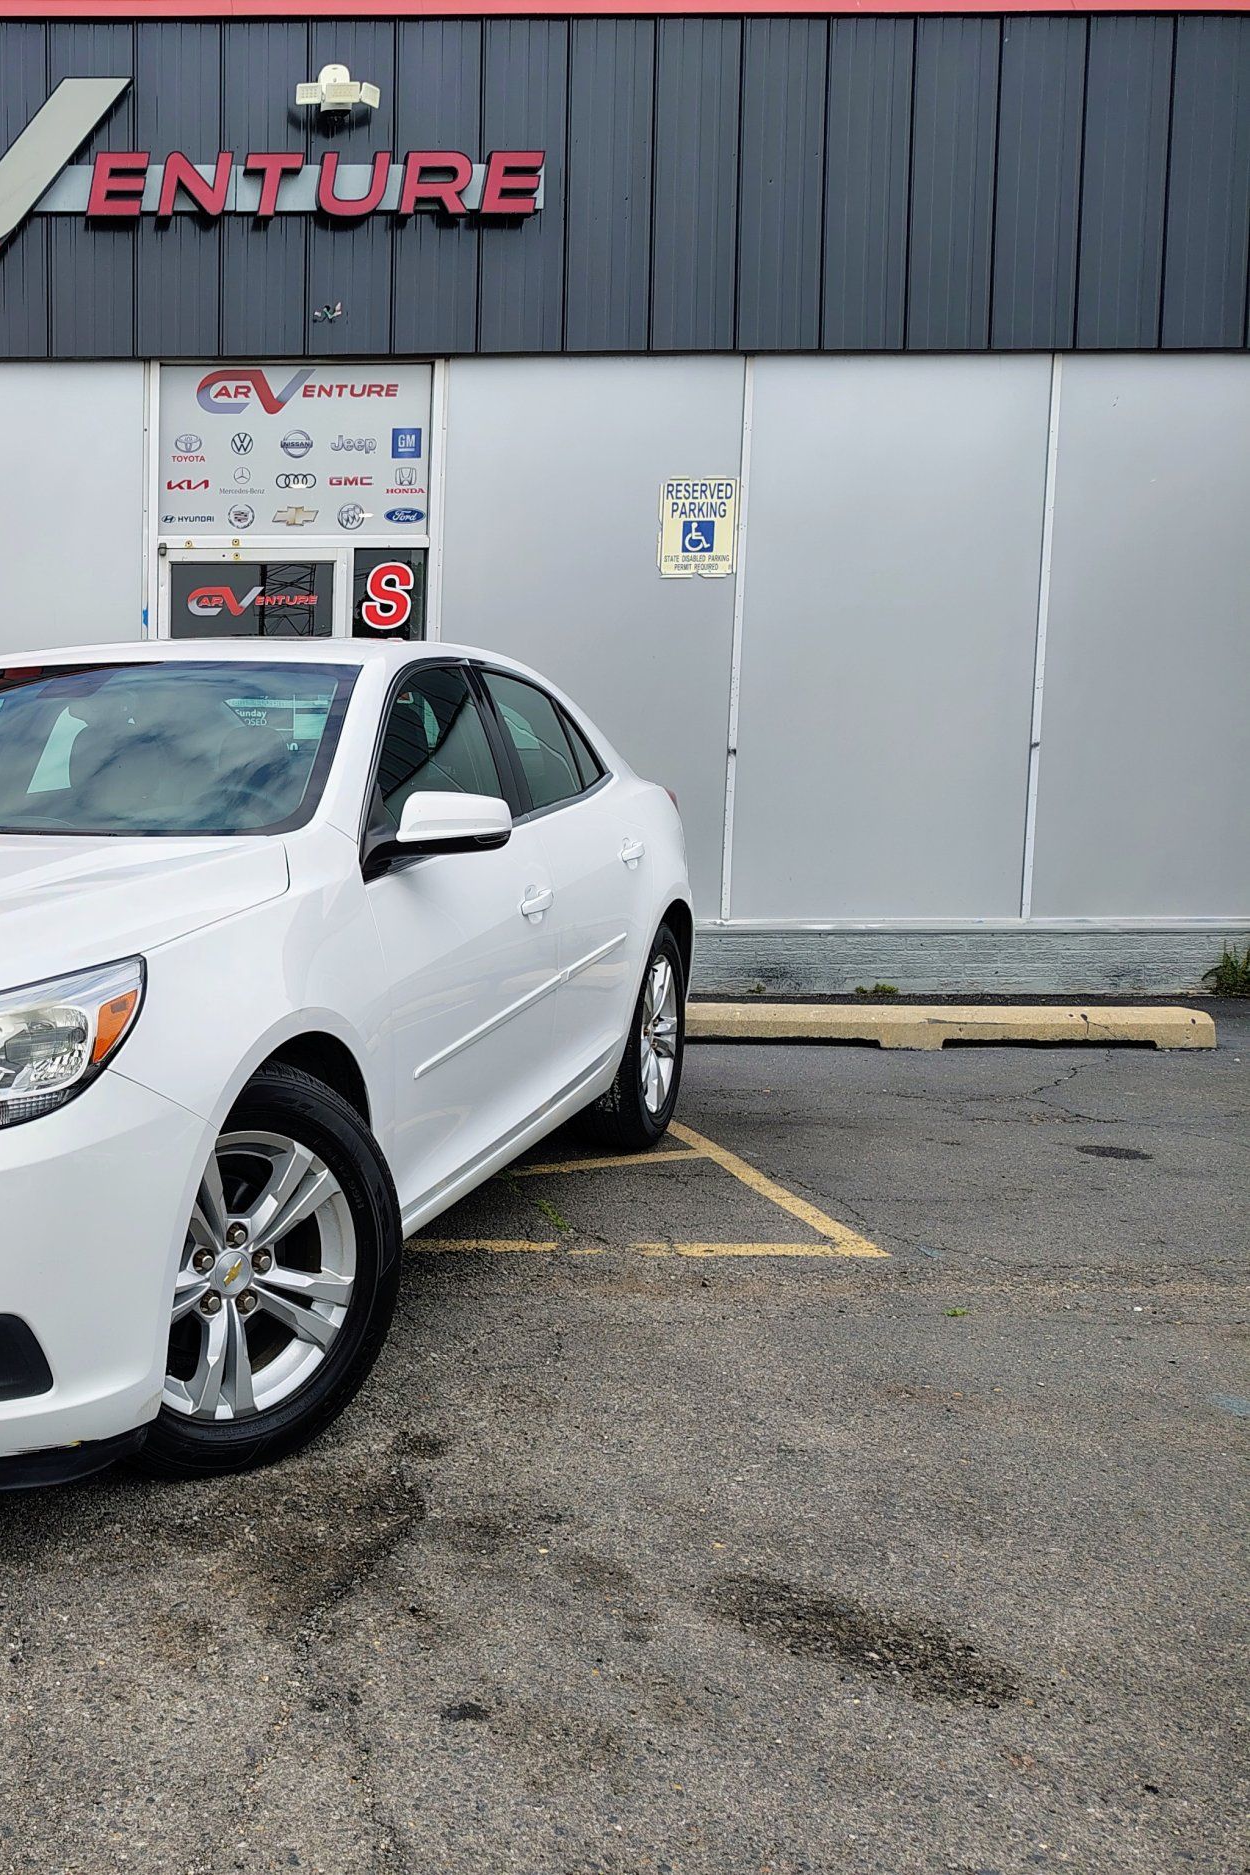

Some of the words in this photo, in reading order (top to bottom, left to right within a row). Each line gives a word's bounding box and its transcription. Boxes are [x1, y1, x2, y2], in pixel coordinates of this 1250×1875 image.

[282, 440, 311, 448] NISSAN
[330, 434, 377, 454] Jeep
[397, 434, 416, 448] GM
[171, 455, 206, 463] TOYOTA
[166, 479, 210, 490] KIA
[329, 476, 373, 486] GMC
[218, 487, 266, 495] Mercedes-Benz
[666, 483, 734, 500] RESERVED
[671, 501, 727, 518] PARKING
[177, 515, 215, 523] HYUNDAI
[392, 510, 418, 521] Ford
[707, 554, 730, 562] PARKING
[362, 562, 414, 630] S
